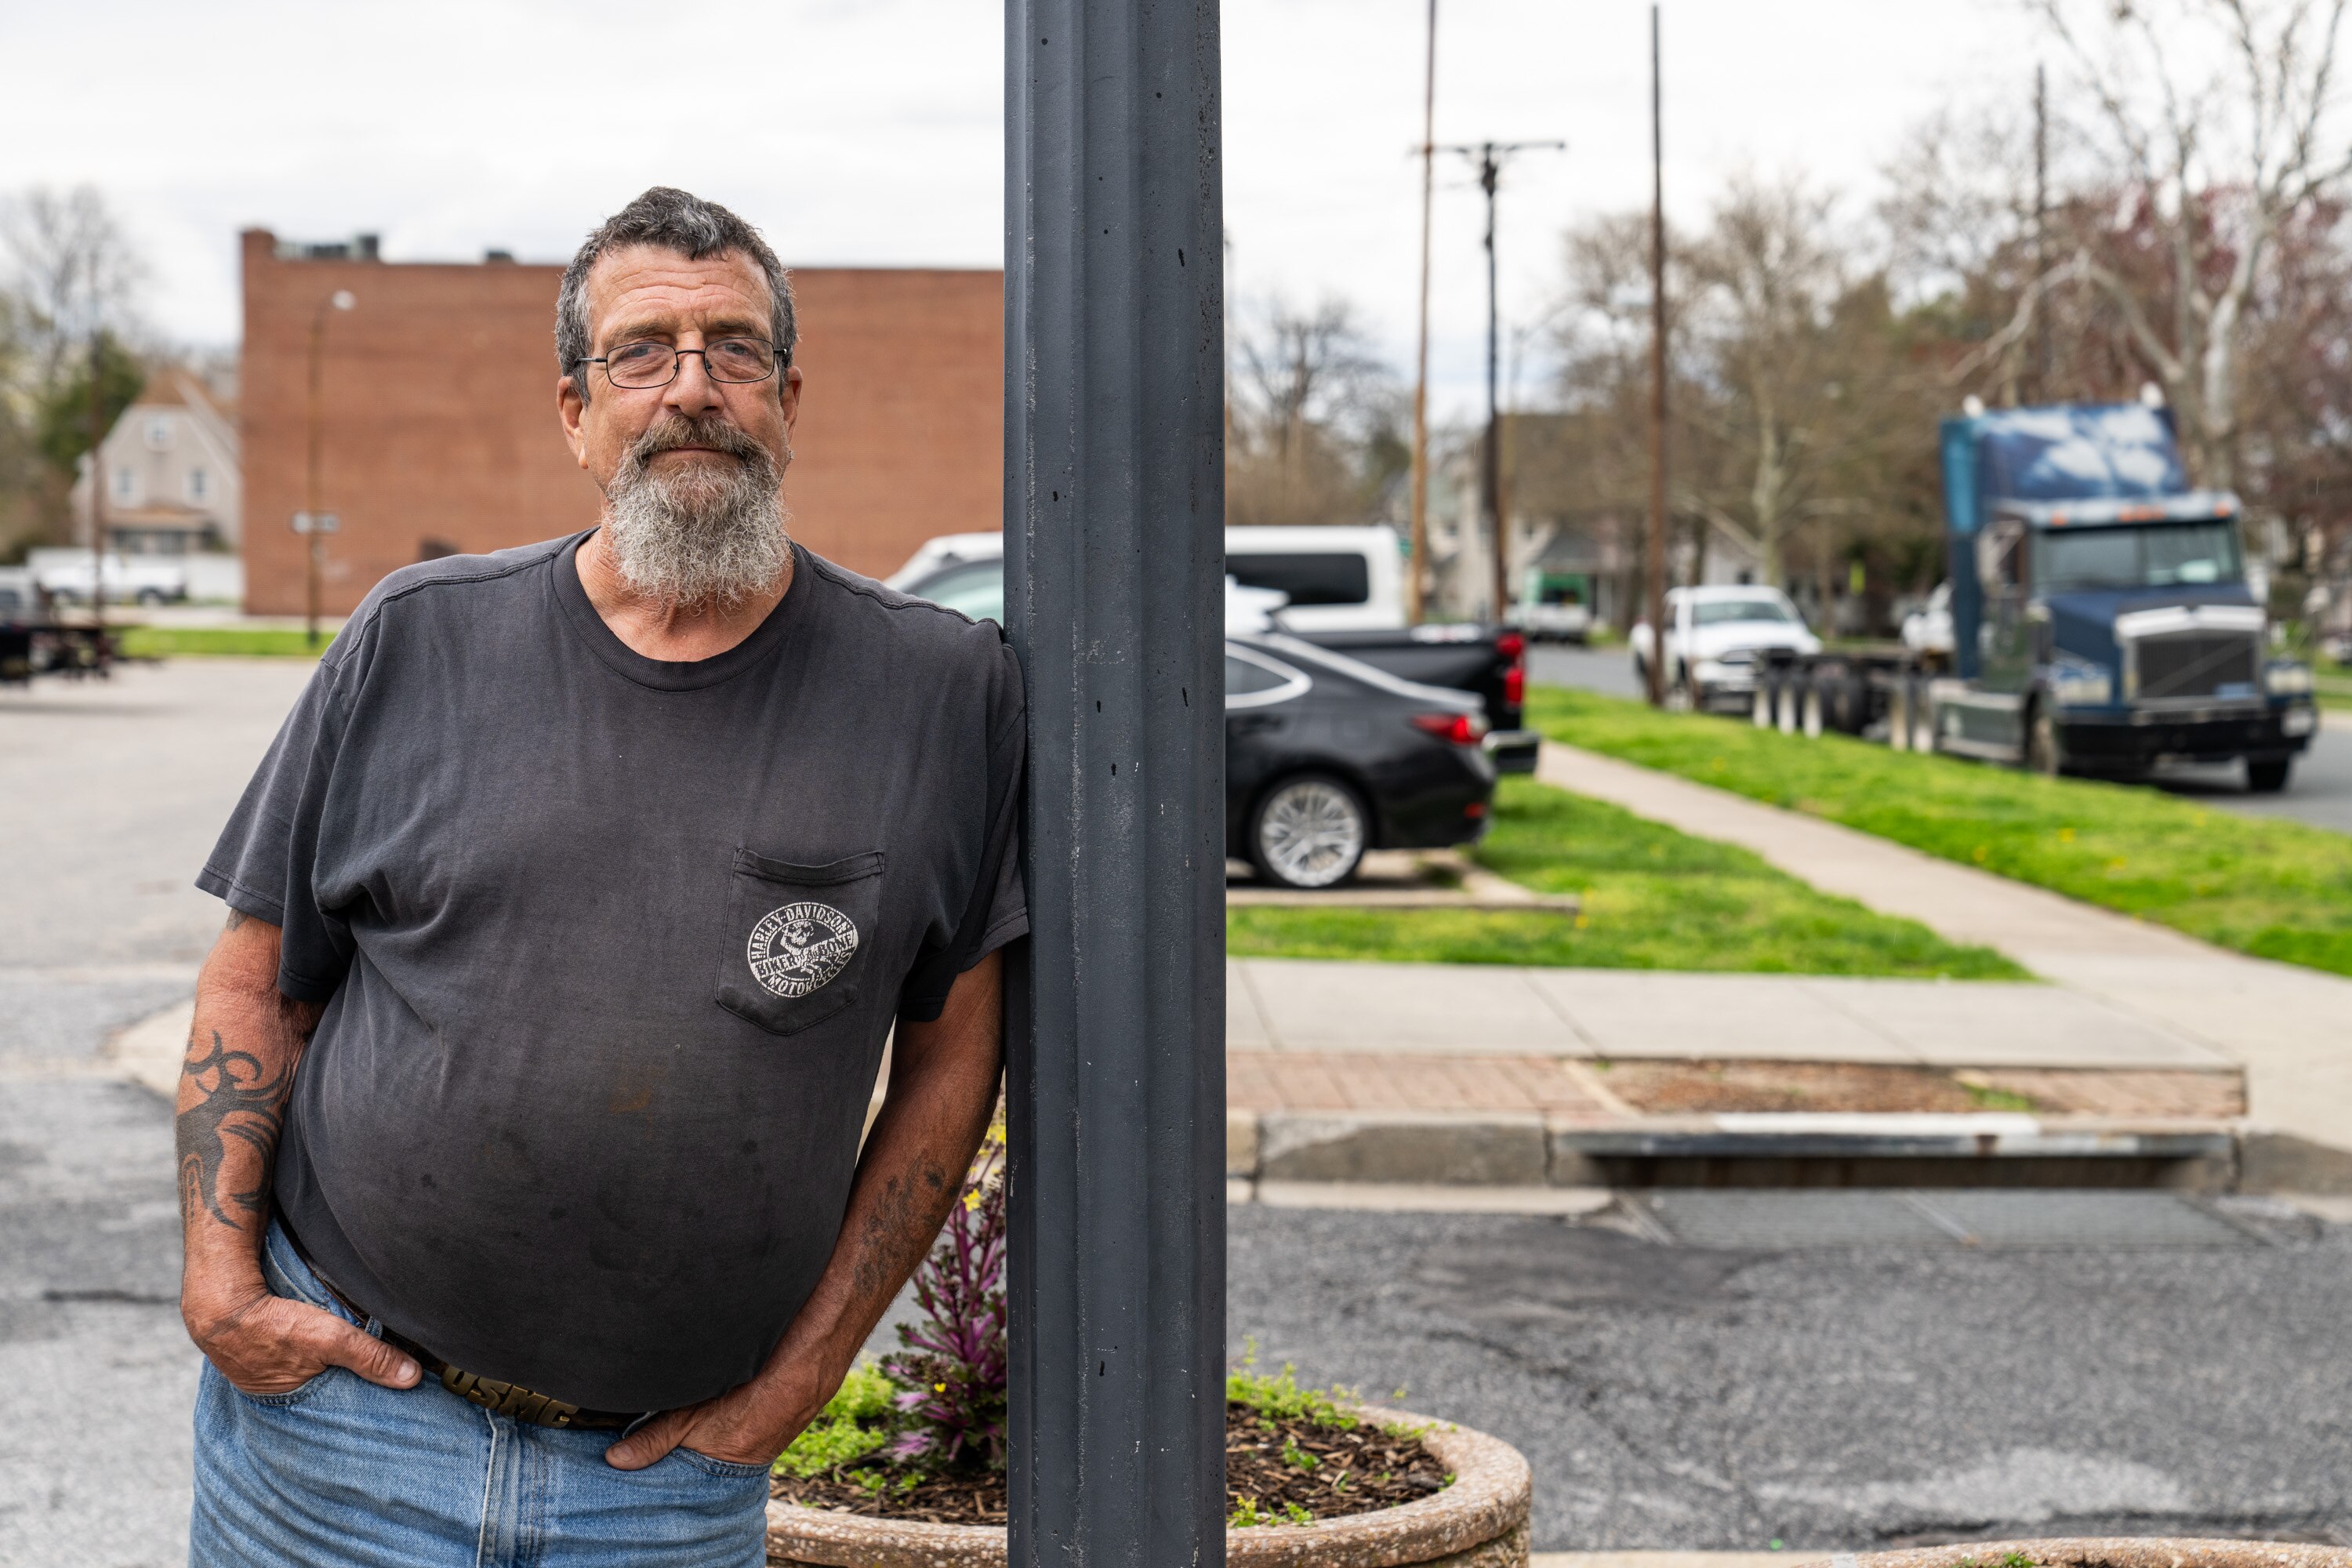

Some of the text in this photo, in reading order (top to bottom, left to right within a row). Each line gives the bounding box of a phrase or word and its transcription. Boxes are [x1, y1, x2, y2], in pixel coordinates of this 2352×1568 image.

[751, 905, 851, 960] HARLEY-DAVIDSON
[755, 956, 797, 978] BIKER
[441, 1365, 579, 1428] USMC
